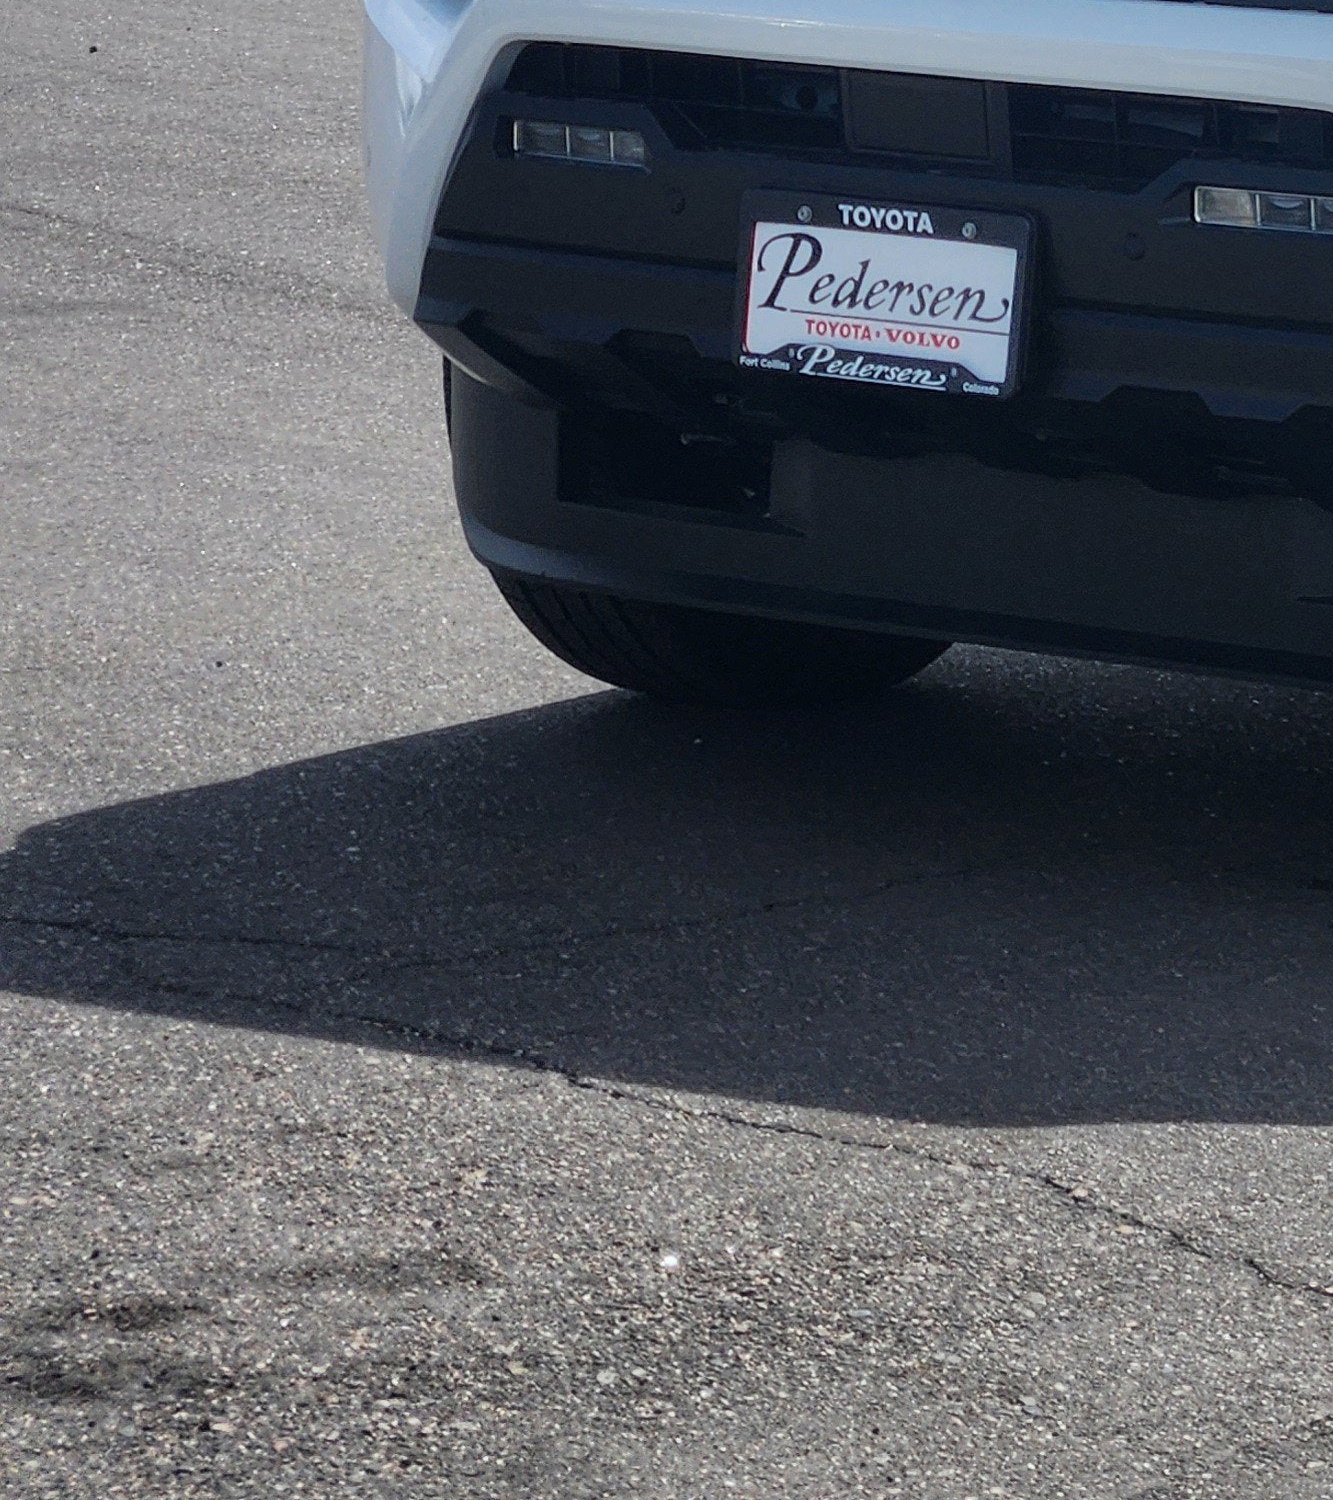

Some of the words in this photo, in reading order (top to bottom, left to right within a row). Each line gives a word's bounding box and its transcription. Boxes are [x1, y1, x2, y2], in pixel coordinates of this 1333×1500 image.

[837, 203, 934, 234] TOYOTA
[756, 232, 1010, 323] Pedersen
[804, 319, 872, 342] TOYOTA
[885, 328, 960, 350] VOLVO
[796, 343, 946, 387] Pedersen
